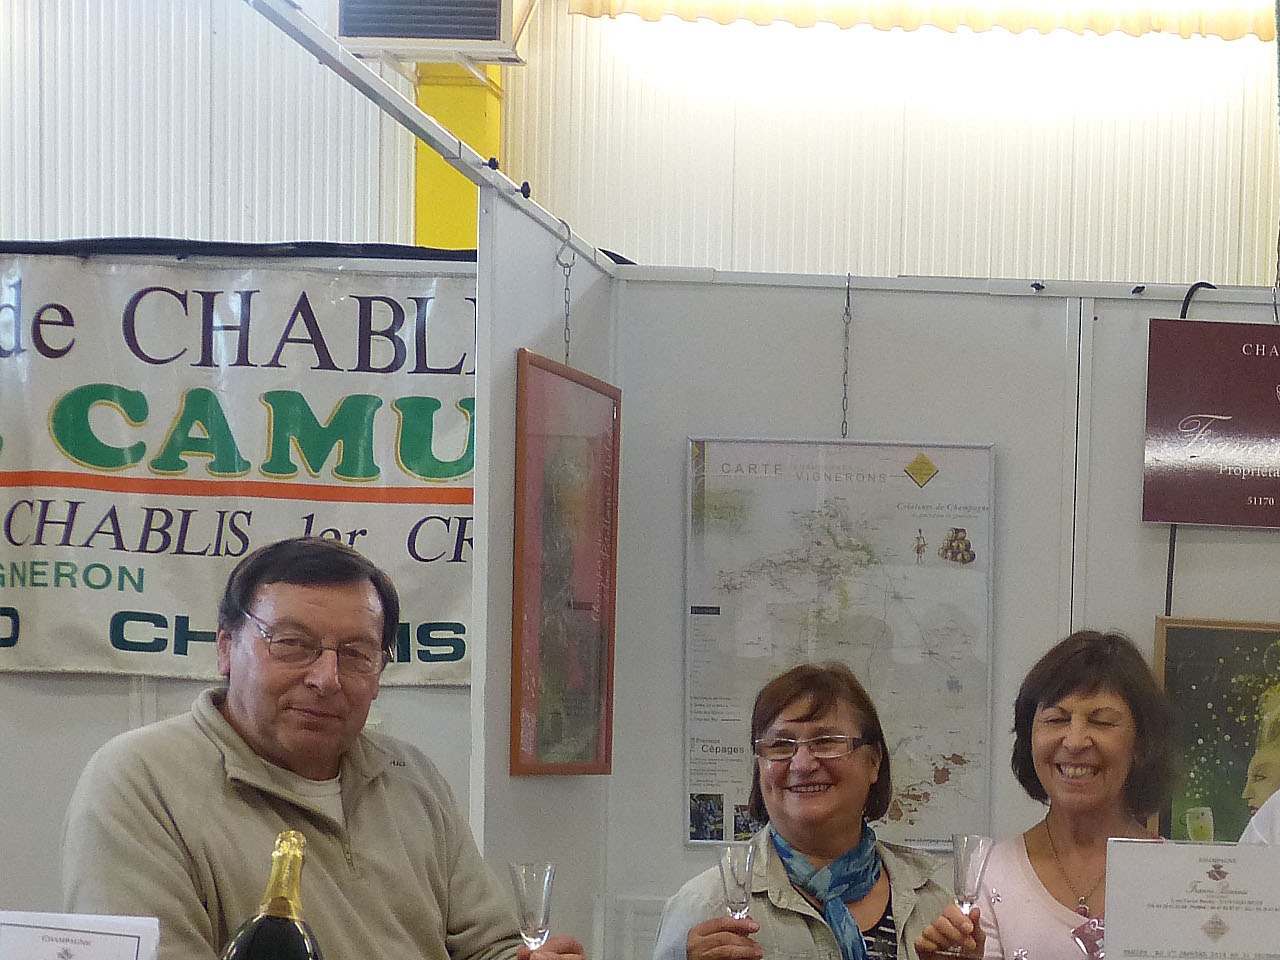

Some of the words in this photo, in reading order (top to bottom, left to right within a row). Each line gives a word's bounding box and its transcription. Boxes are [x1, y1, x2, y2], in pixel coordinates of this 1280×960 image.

[721, 462, 783, 476] CARTE
[796, 472, 888, 484] VIGNERONS
[1247, 496, 1275, 507] 51170
[3, 499, 252, 558] CHABLIS
